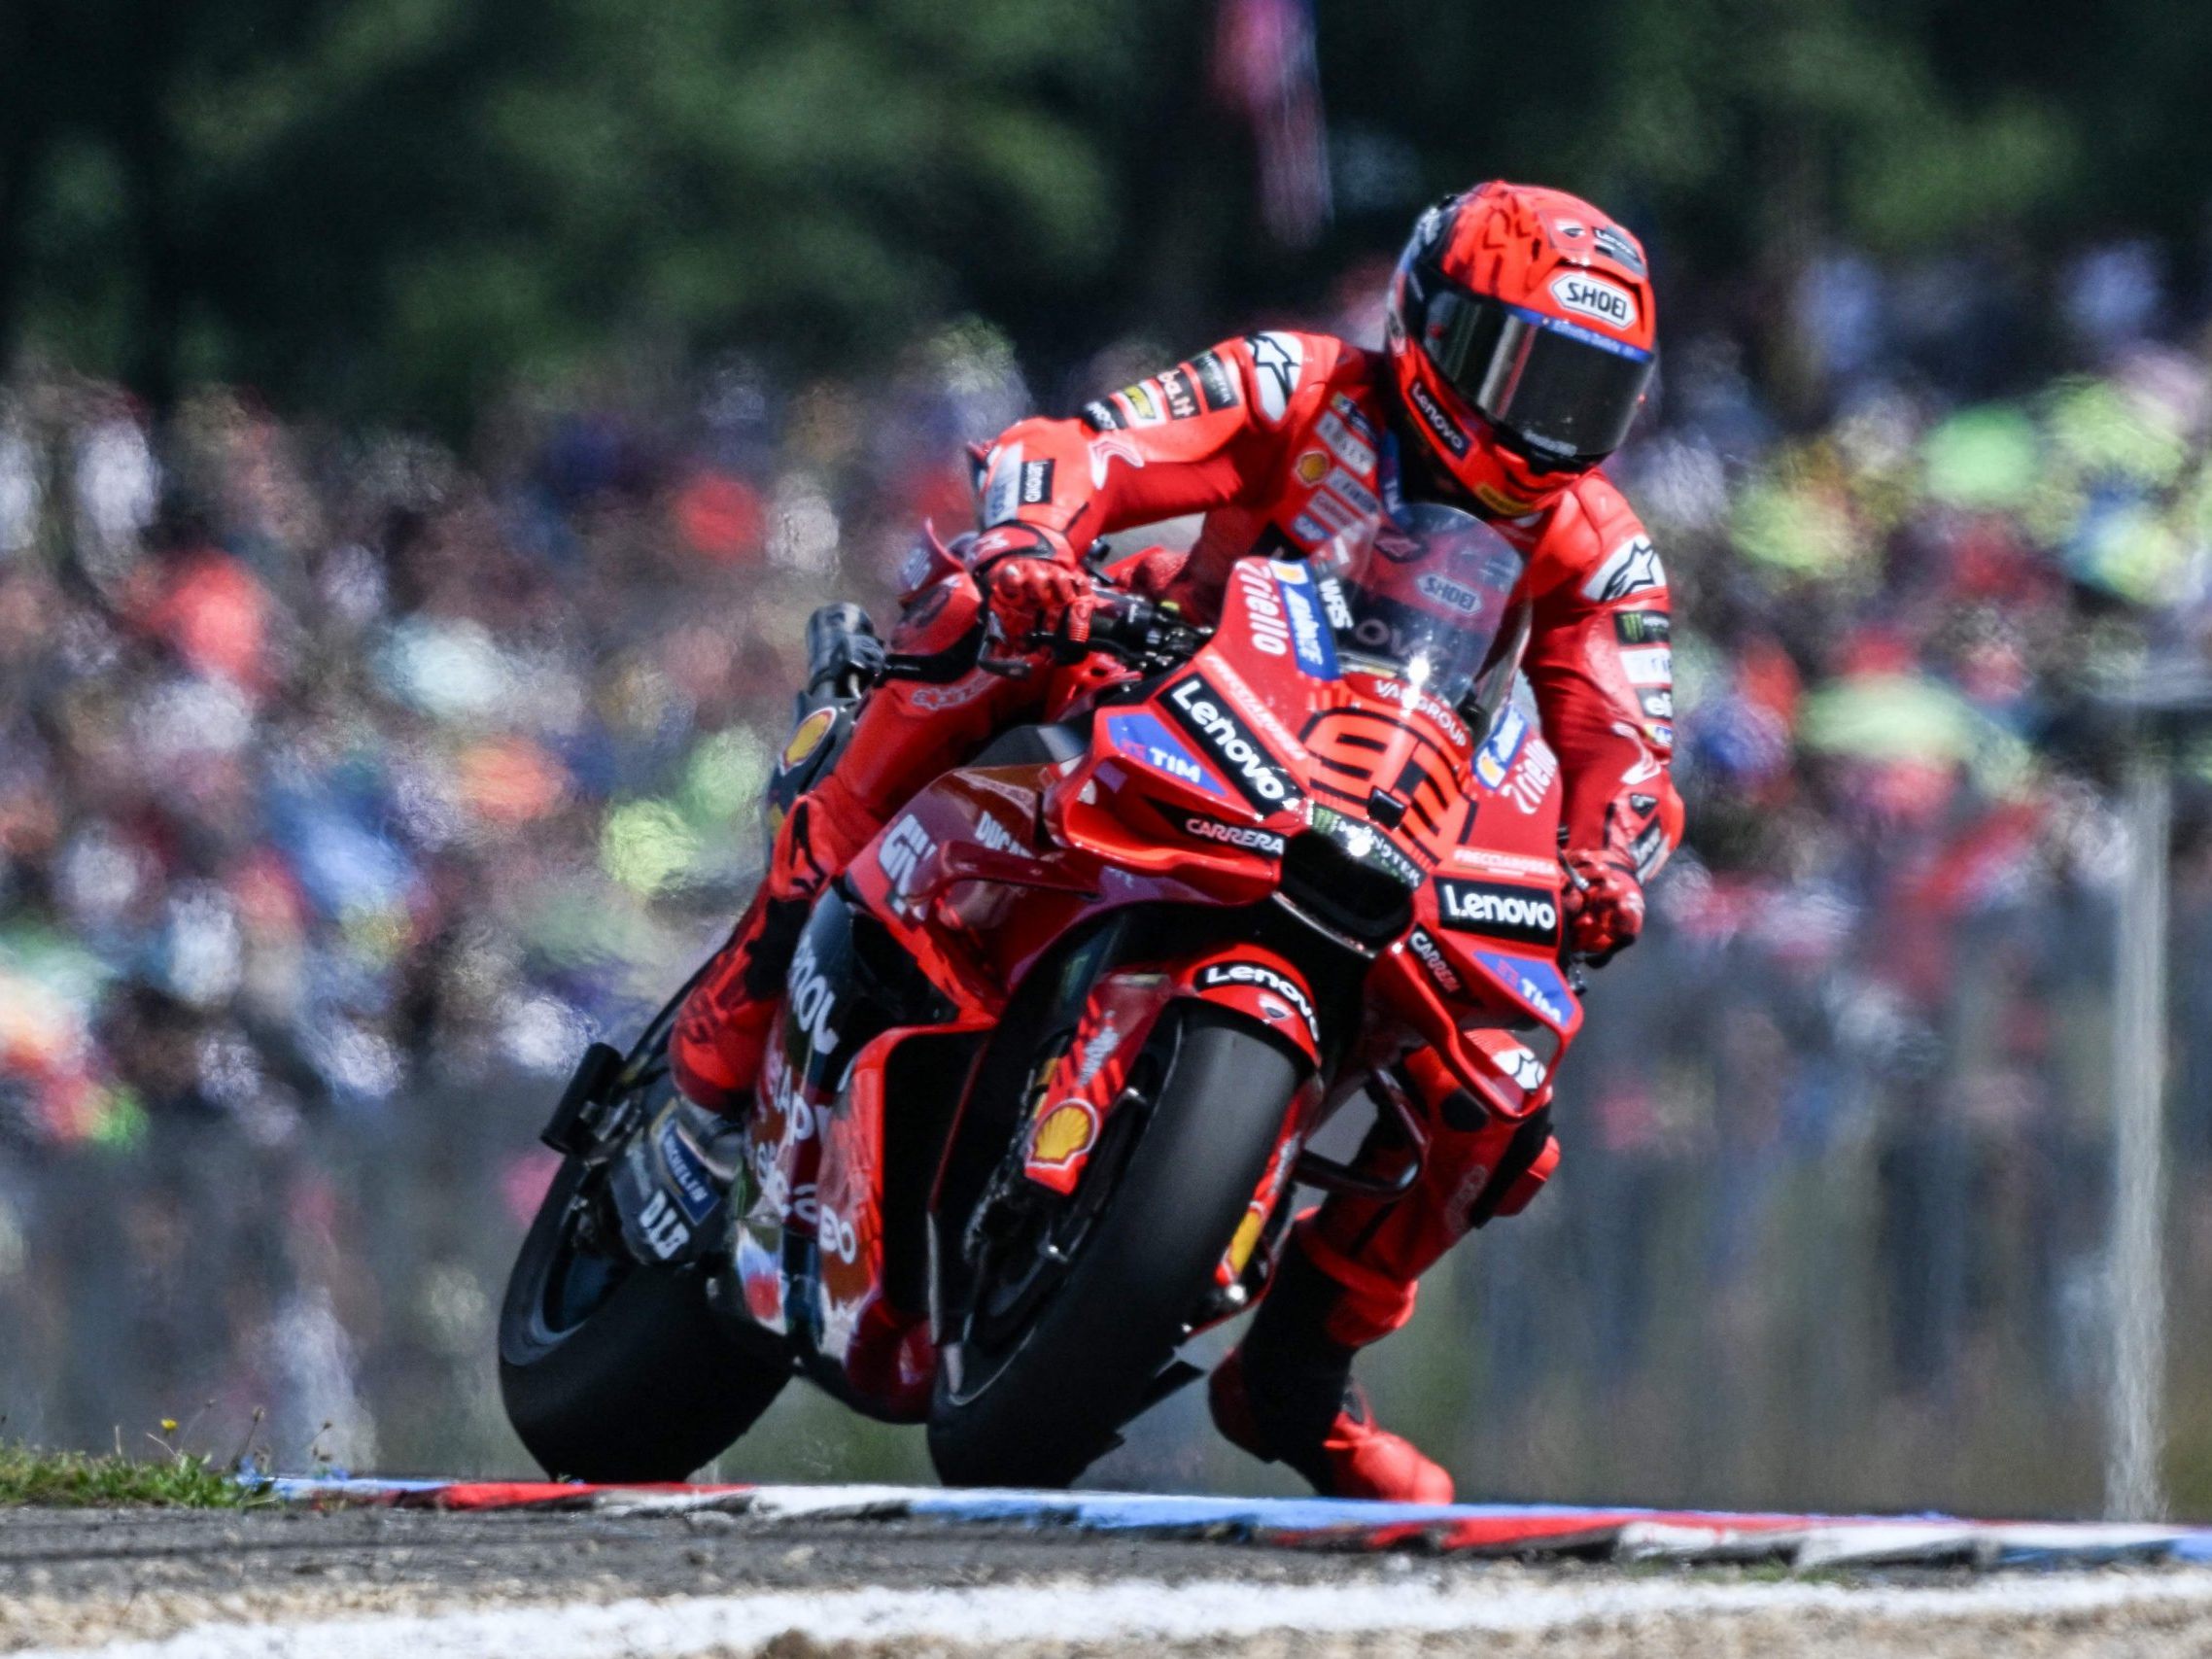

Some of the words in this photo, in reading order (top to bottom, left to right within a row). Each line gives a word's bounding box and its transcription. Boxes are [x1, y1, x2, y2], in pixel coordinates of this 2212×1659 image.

[1567, 282, 1626, 320] SHOEI
[1413, 382, 1463, 449] Lenovo
[1024, 461, 1050, 502] Lenovo
[1239, 573, 1290, 655] riello
[1319, 578, 1354, 629] WRS
[1426, 576, 1476, 610] SHOEI
[1171, 680, 1285, 800] Lenovo
[1150, 745, 1201, 782] TIM
[1186, 818, 1284, 855] CARRERA
[1443, 885, 1556, 930] Lenovo
[1521, 978, 1561, 1022] TIM
